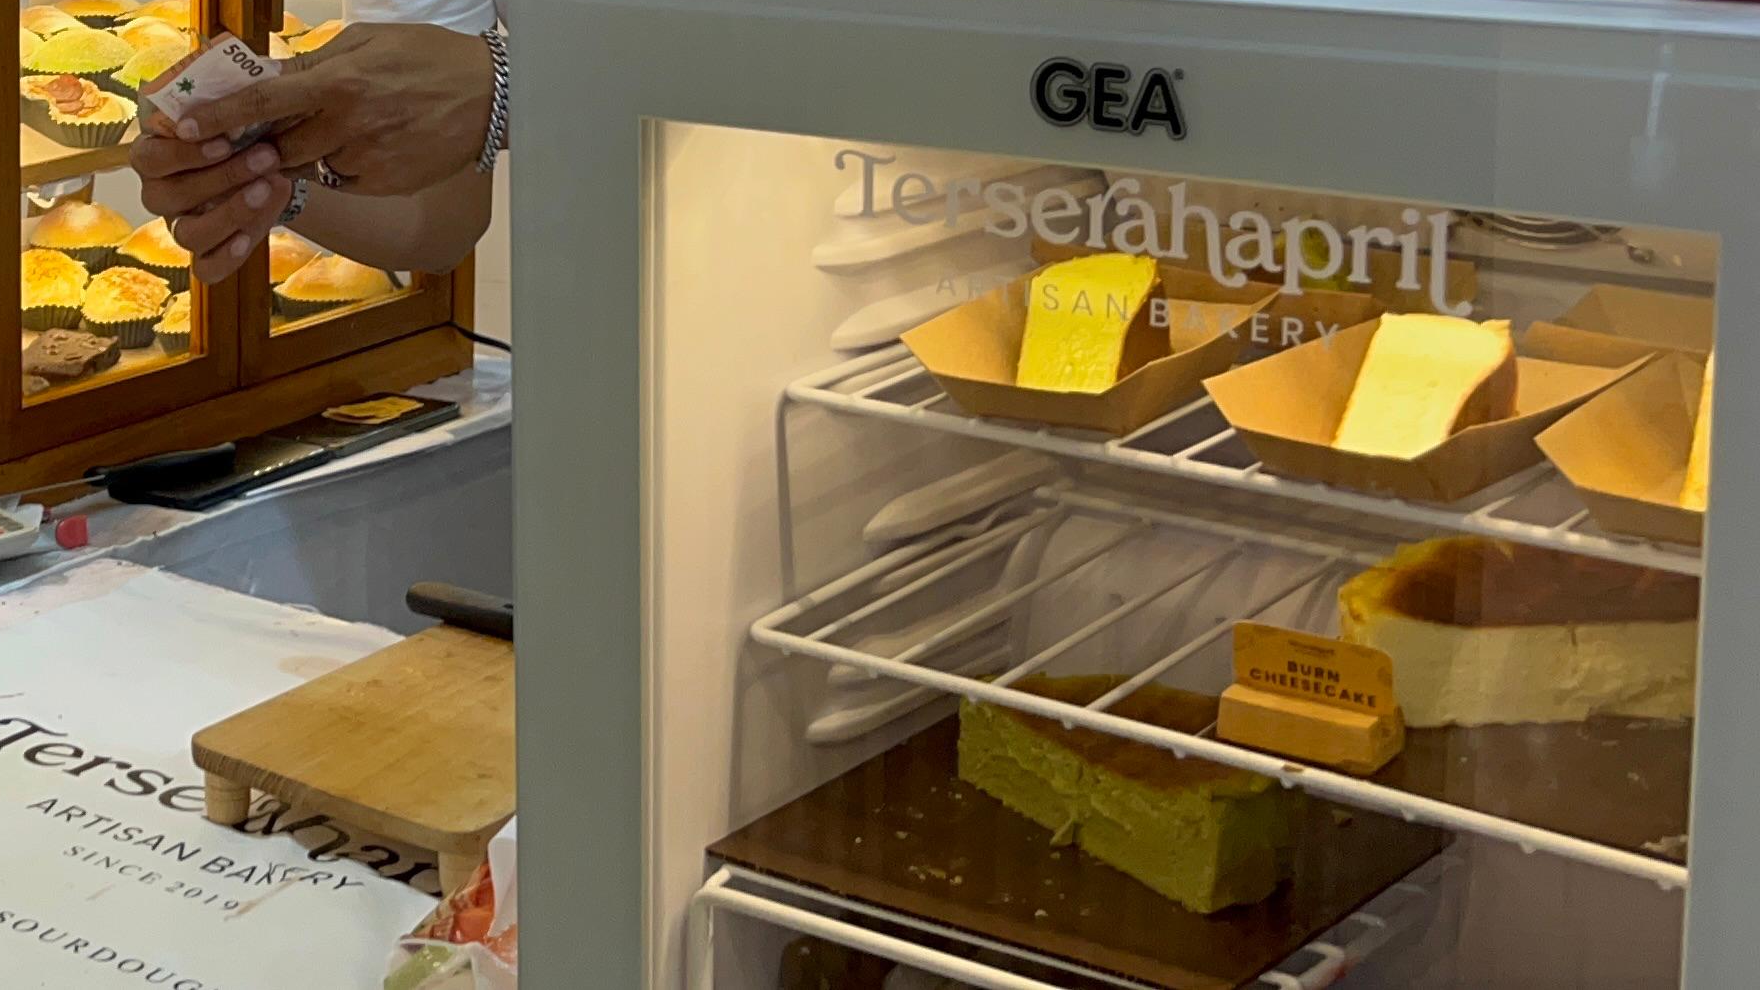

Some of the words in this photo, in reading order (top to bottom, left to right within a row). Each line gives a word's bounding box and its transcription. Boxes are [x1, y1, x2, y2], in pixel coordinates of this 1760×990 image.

[223, 43, 265, 77] 5000
[1030, 57, 1187, 141] GEA
[835, 149, 1473, 317] Terserahapril
[935, 274, 1130, 323] ARTISAN
[1149, 297, 1340, 352] BAKERY
[1249, 667, 1378, 708] CHEESECAKE
[1286, 660, 1341, 683] BURN
[25, 798, 202, 862] ARTISAN
[199, 855, 365, 891] BAKERY
[63, 844, 163, 886] SINCE
